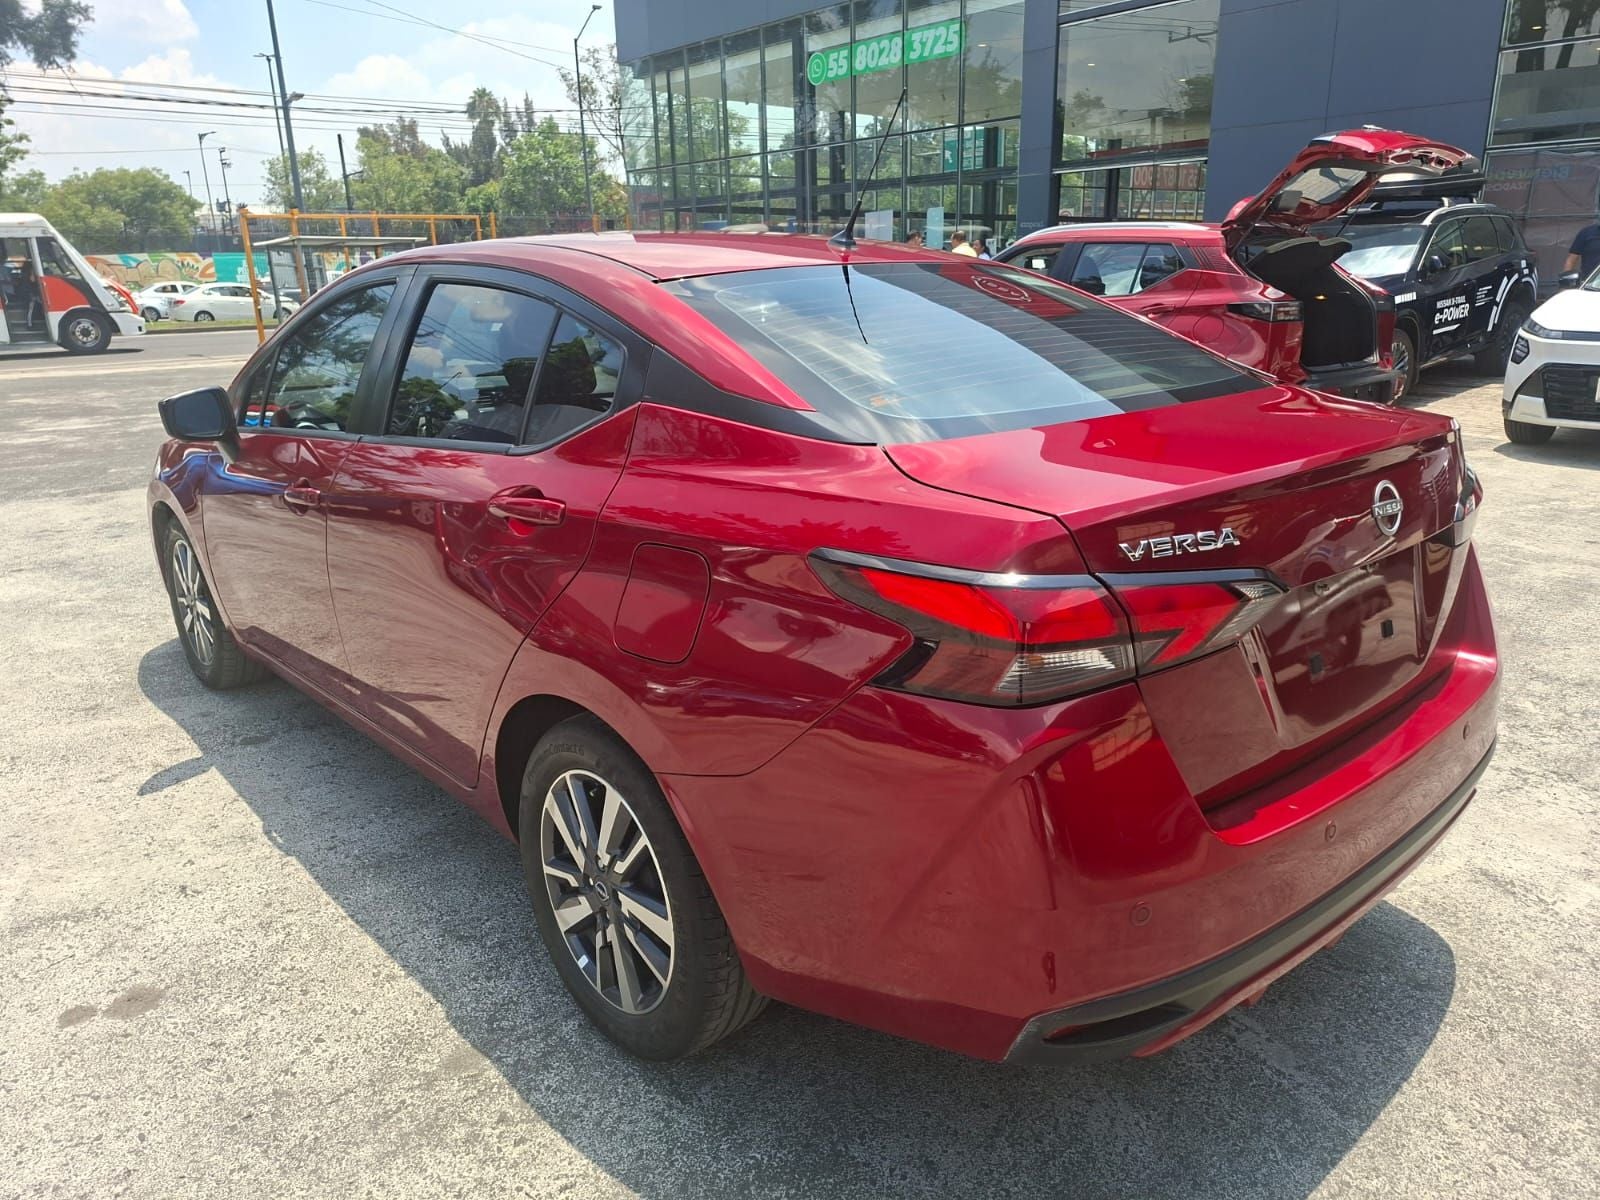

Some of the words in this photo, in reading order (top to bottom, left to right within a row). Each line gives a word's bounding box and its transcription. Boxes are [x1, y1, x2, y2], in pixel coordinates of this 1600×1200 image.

[826, 49, 847, 77] 55
[855, 37, 903, 70] 8028
[909, 23, 961, 60] 3725
[1434, 303, 1470, 325] e-POWER
[1118, 527, 1241, 563] VERSA
